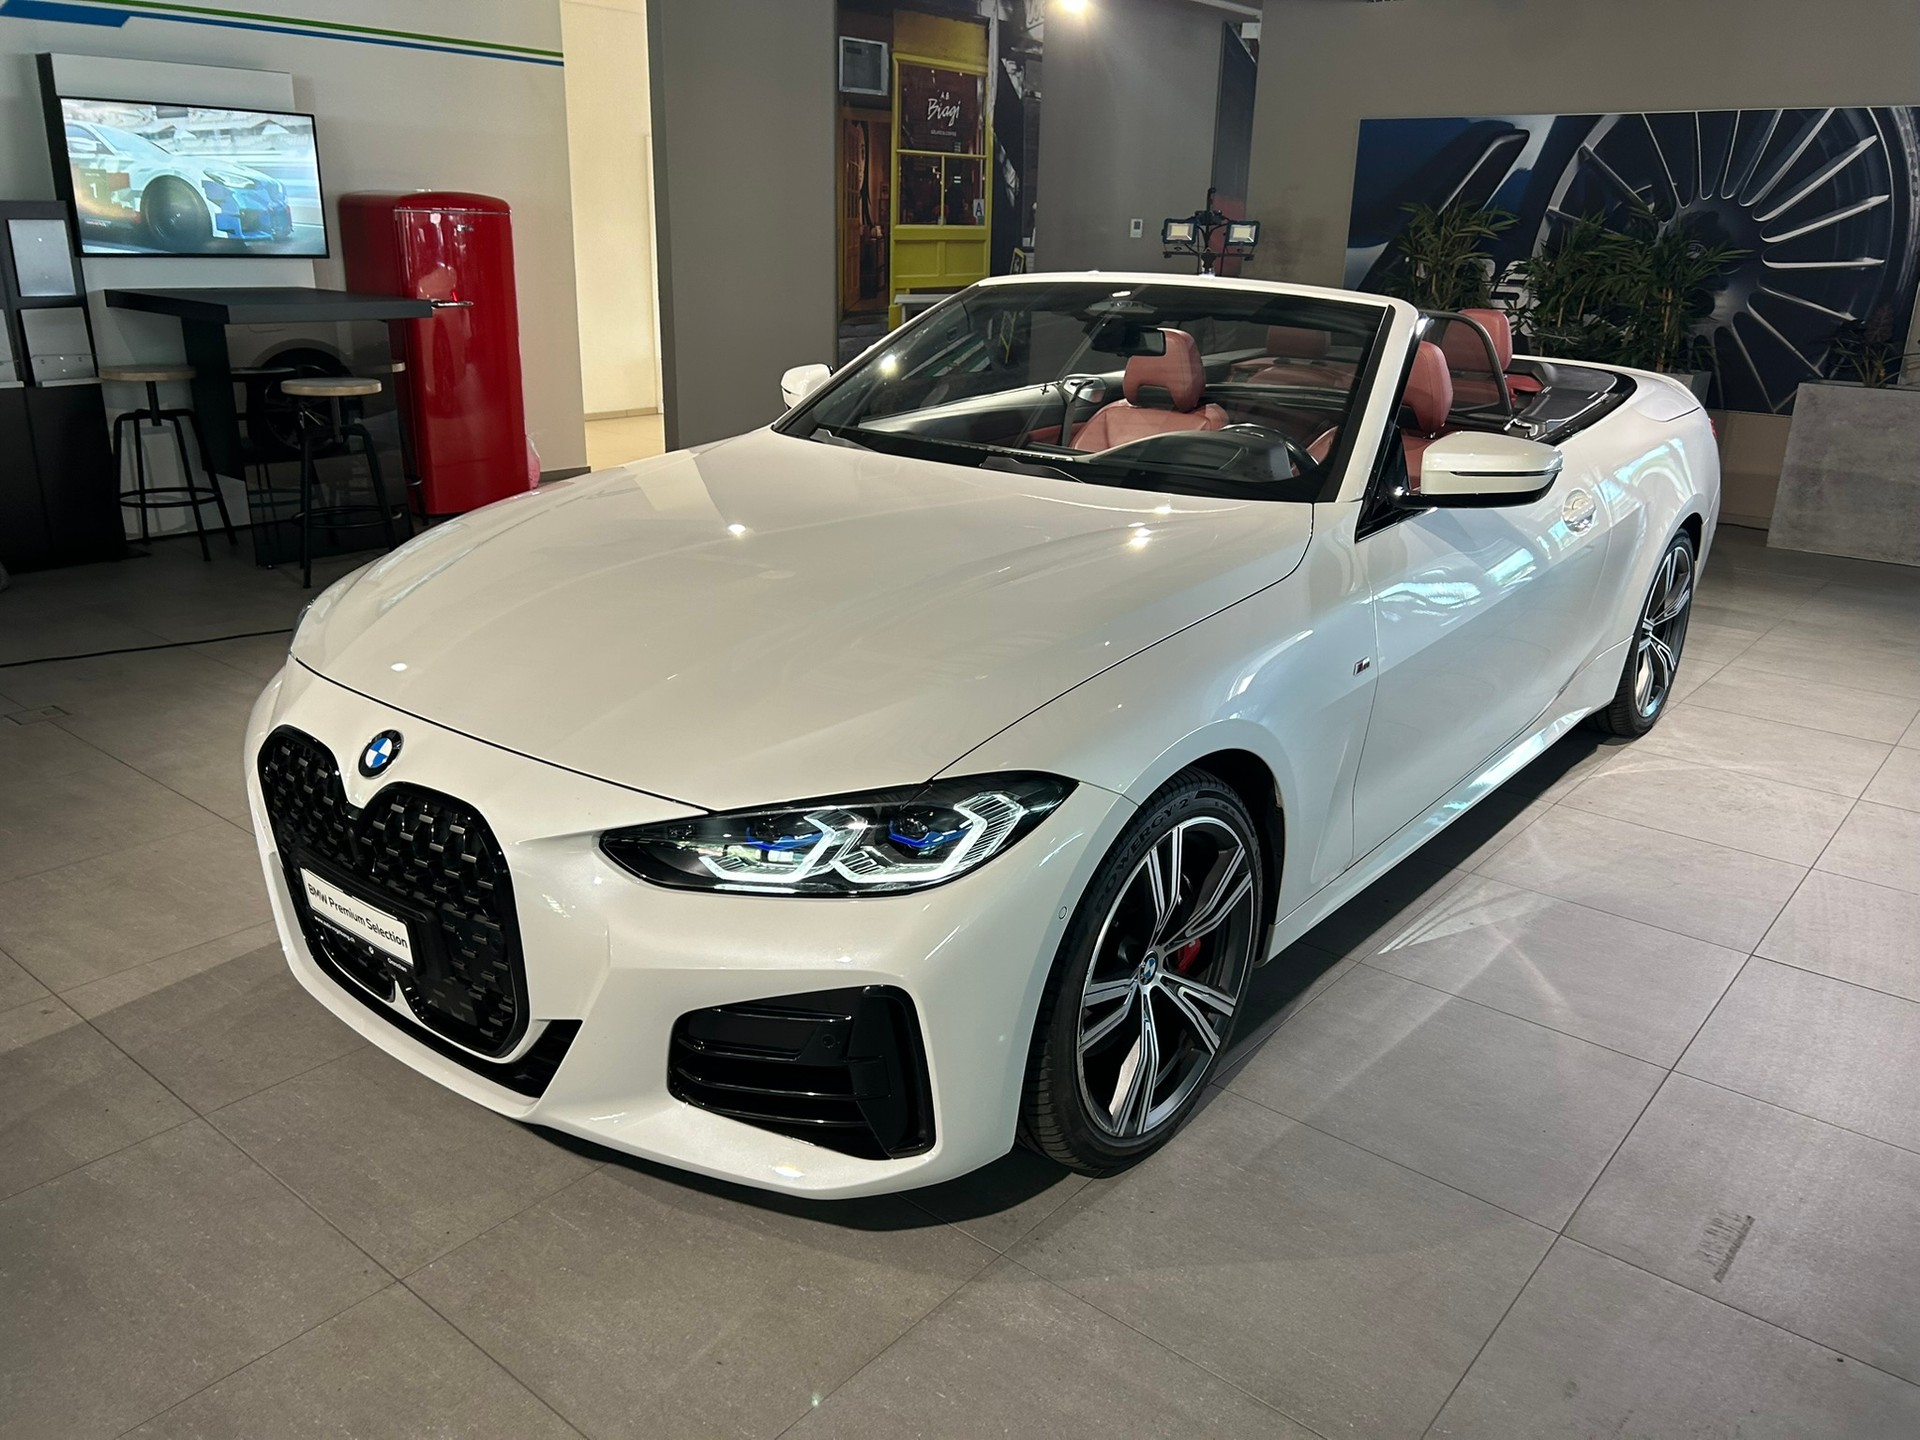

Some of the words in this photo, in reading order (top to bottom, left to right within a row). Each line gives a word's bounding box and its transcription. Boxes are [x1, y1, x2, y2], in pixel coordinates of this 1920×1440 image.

[928, 98, 961, 127] Biagi
[975, 202, 983, 216] A
[308, 883, 328, 904] BMW
[328, 896, 366, 926] Premium
[365, 917, 408, 948] Selection
